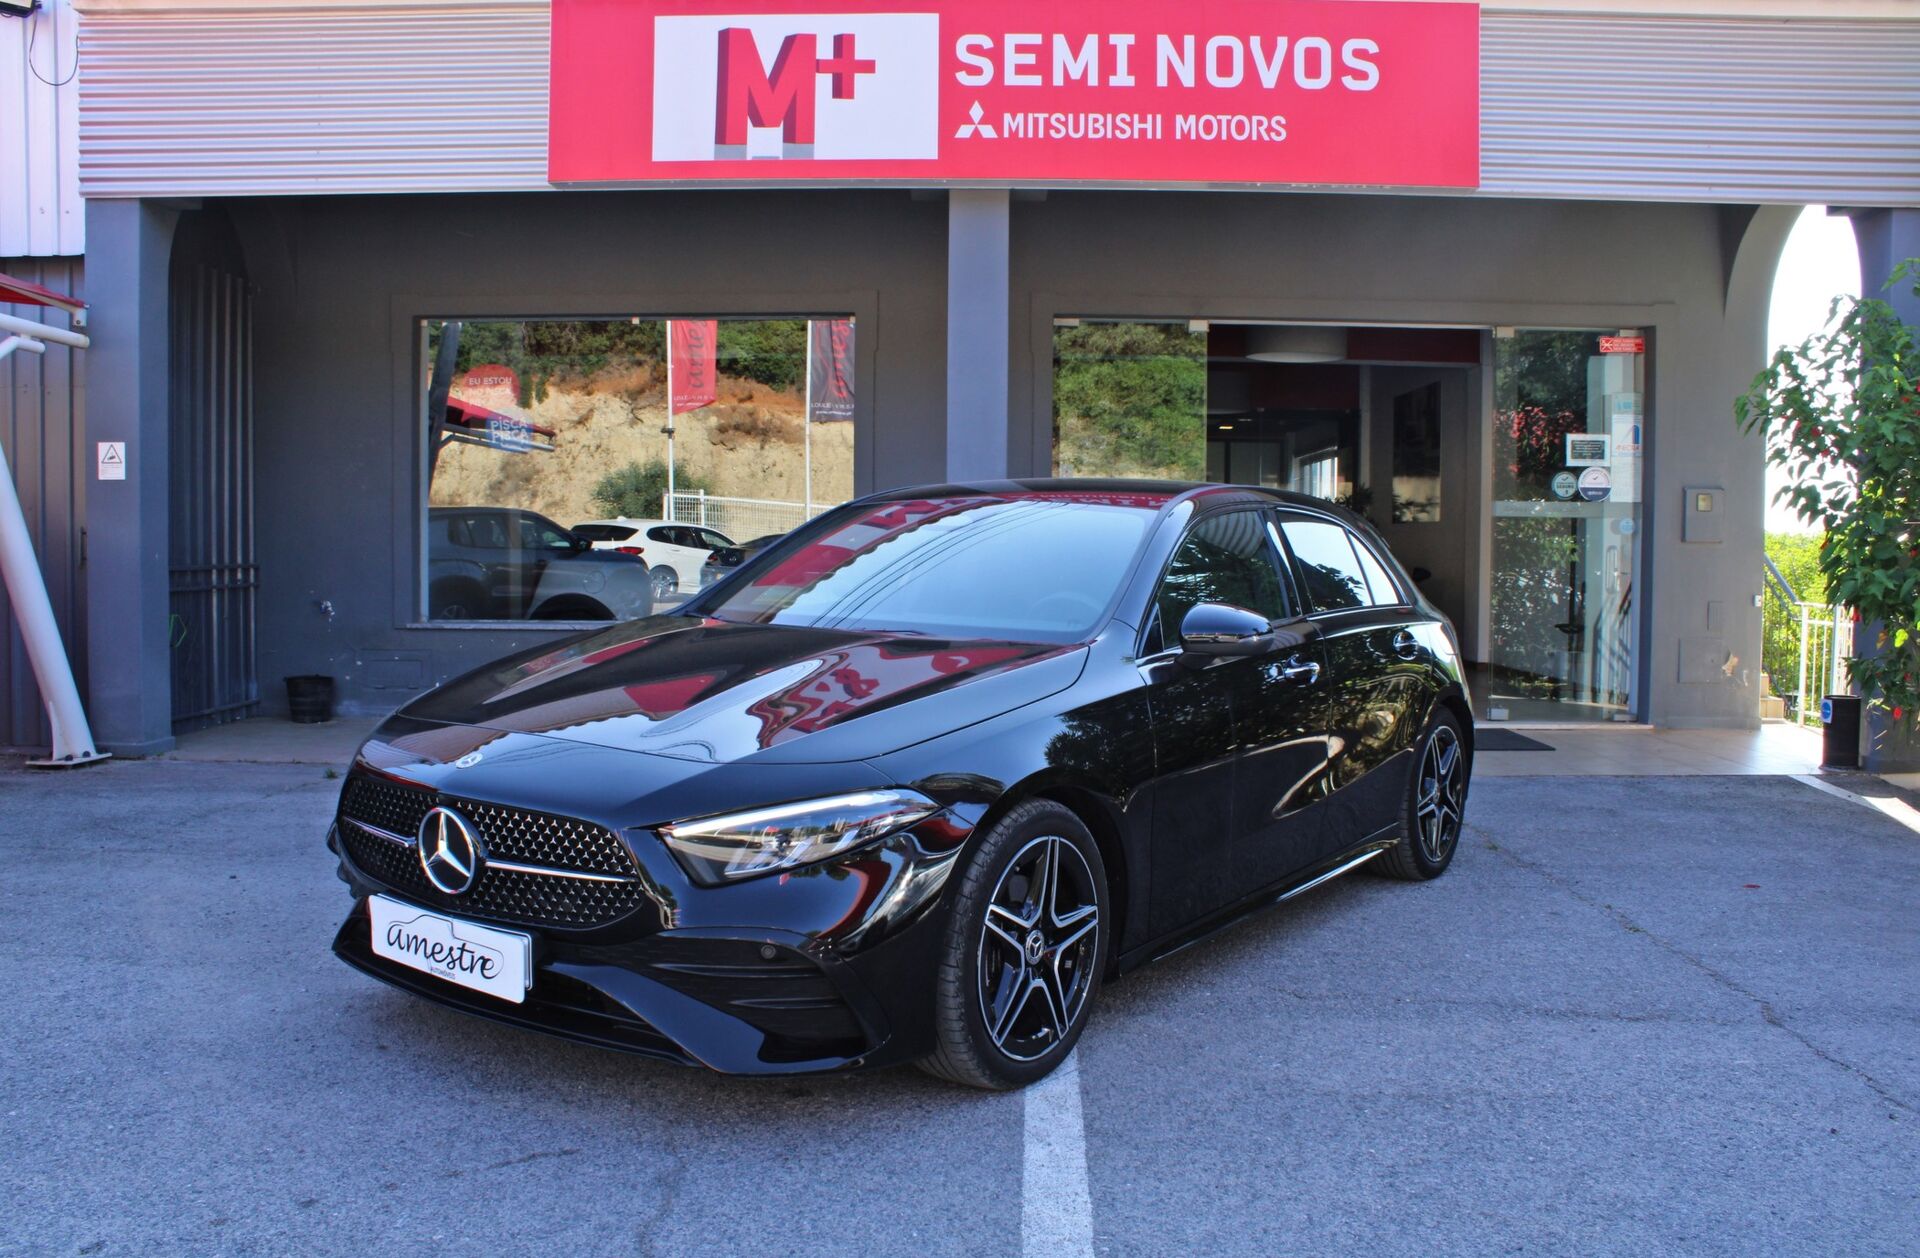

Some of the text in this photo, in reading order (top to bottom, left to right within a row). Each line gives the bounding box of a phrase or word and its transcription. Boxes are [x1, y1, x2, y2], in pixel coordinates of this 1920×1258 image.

[955, 33, 1380, 91] SEMI NOVOS
[1003, 112, 1287, 142] MITSUBISHI MOTORS
[468, 376, 513, 385] EU ESTOU
[386, 923, 496, 980] amestre
